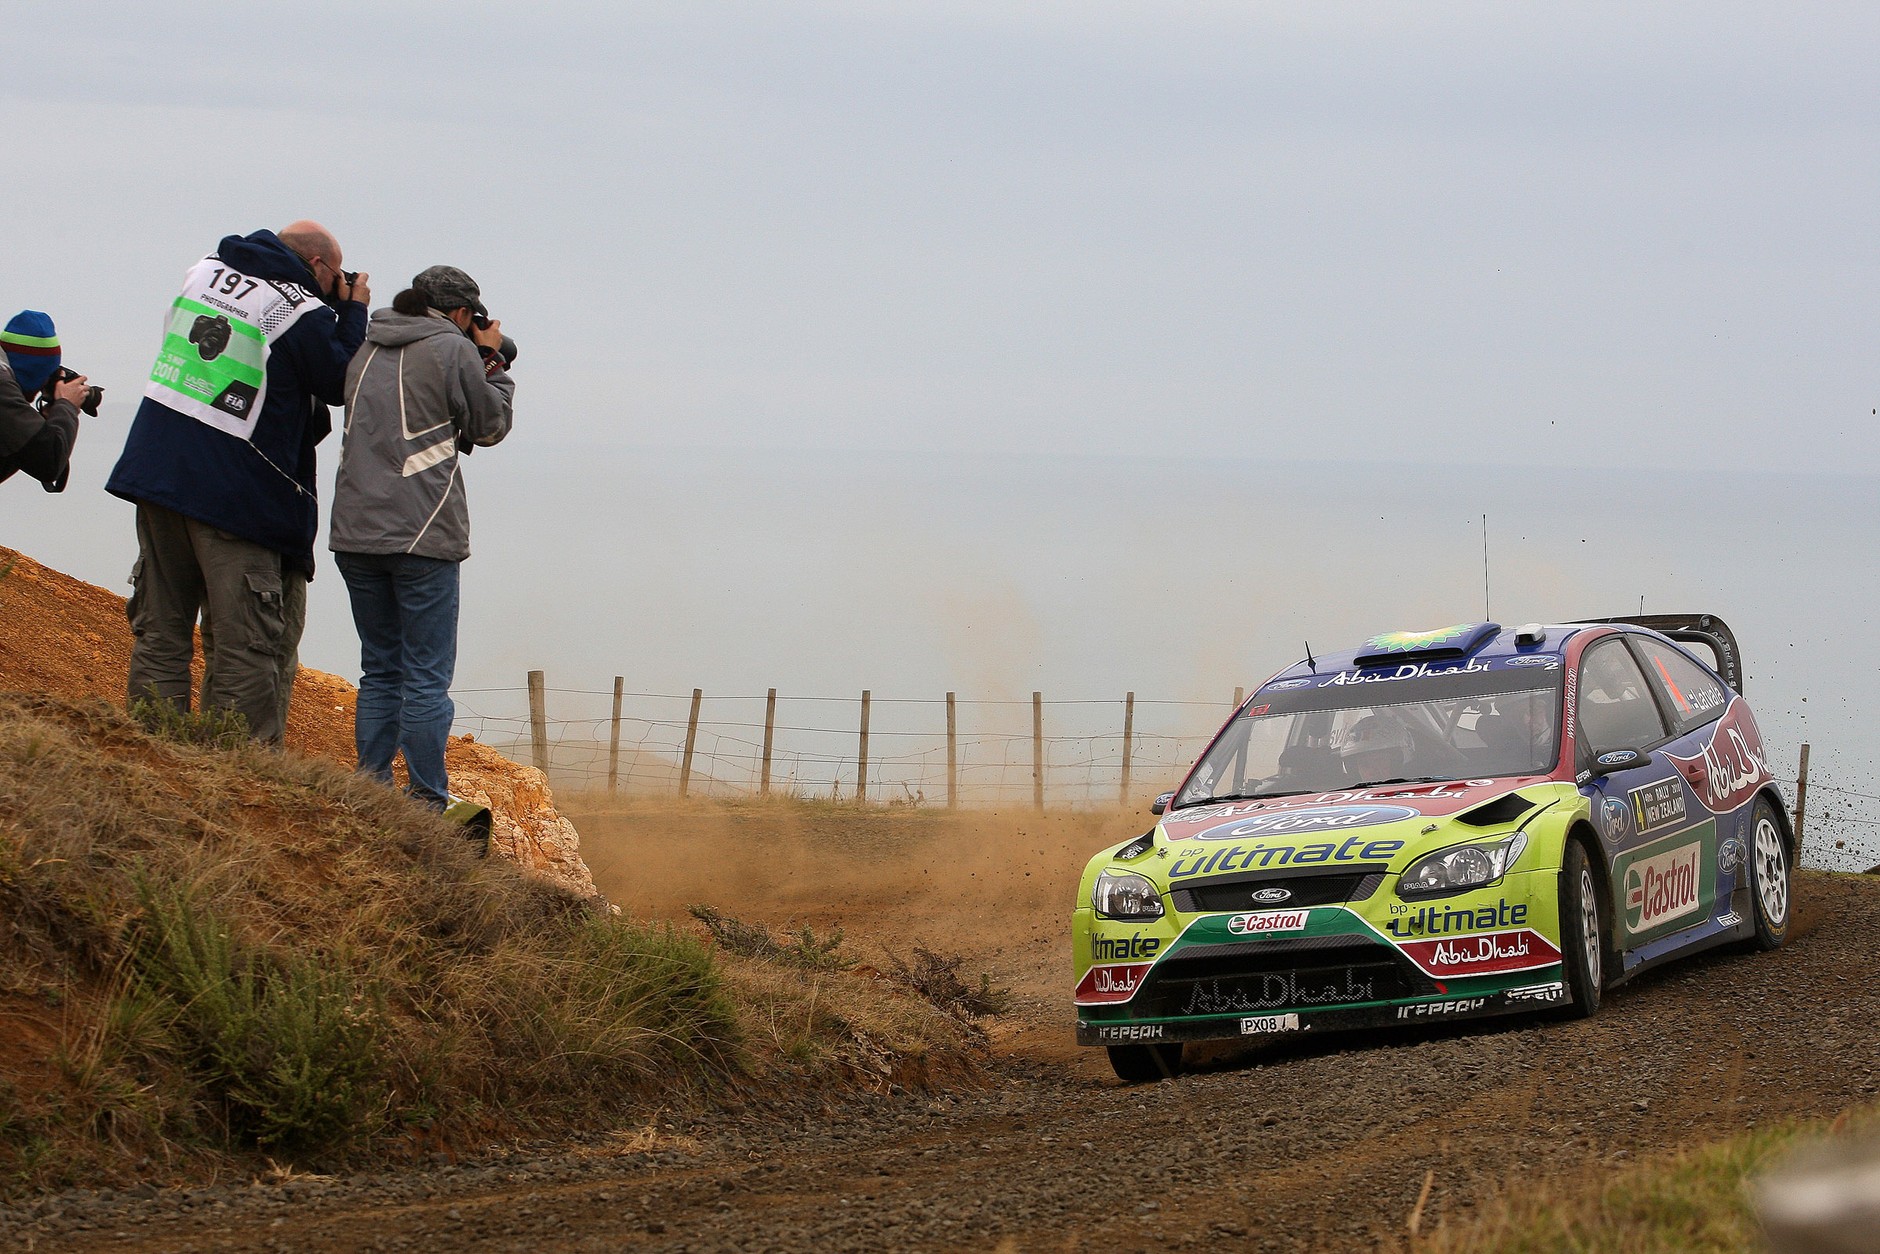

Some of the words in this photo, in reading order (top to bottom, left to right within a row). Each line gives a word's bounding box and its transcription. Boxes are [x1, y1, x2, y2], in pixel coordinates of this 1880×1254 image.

[208, 268, 259, 300] 197
[273, 280, 302, 301] LAND
[200, 293, 249, 319] PHOTOGRAPHER
[153, 360, 180, 383] 2010
[225, 393, 245, 409] FIA
[1605, 752, 1631, 763] Ford
[1655, 784, 1670, 800] RALLY
[1604, 803, 1625, 837] Ford
[1646, 805, 1660, 823] NEW
[1660, 797, 1685, 820] ZEALAND
[1231, 810, 1378, 836] Ford
[1168, 836, 1405, 878] ultimate
[1179, 847, 1205, 858] bp
[1259, 889, 1283, 899] Ford
[1643, 851, 1696, 921] Castrol
[1389, 903, 1408, 916] bp
[1391, 898, 1528, 937] ultimate
[1246, 912, 1303, 931] Castrol
[1244, 1017, 1277, 1031] PX08
